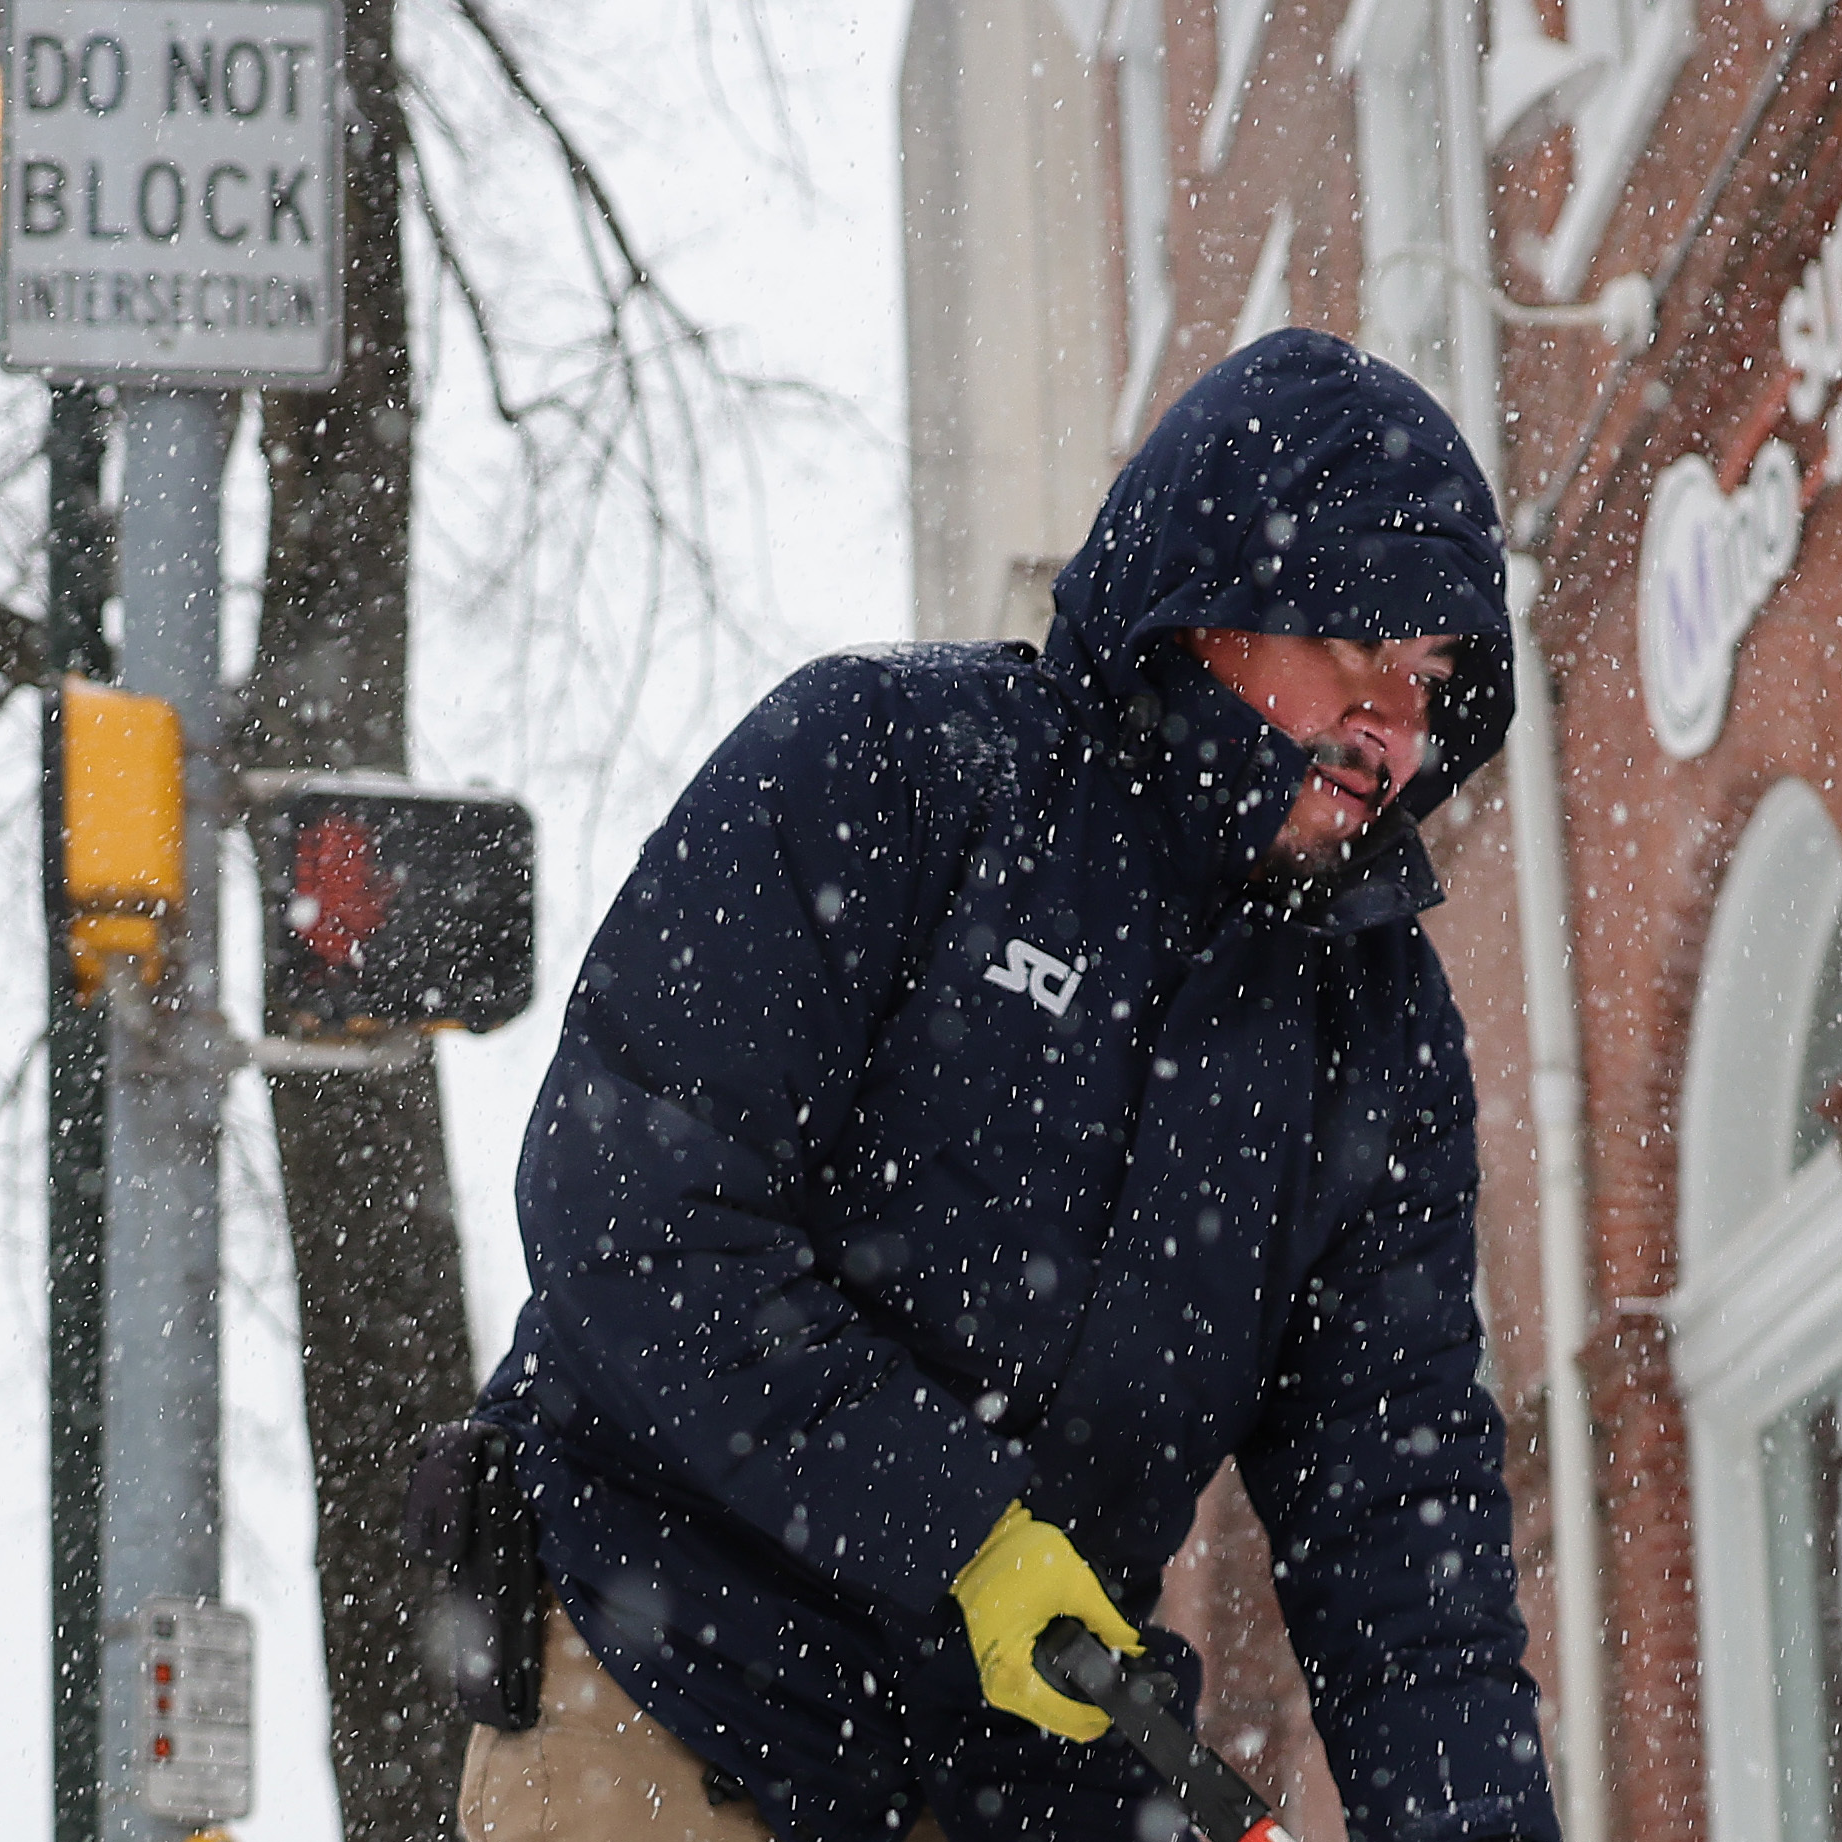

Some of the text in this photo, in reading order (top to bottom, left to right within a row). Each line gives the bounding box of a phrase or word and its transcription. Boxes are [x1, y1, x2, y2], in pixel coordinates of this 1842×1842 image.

[24, 35, 316, 119] DO NOT
[21, 160, 313, 244] BLOCK
[19, 269, 317, 331] INTERSECTION
